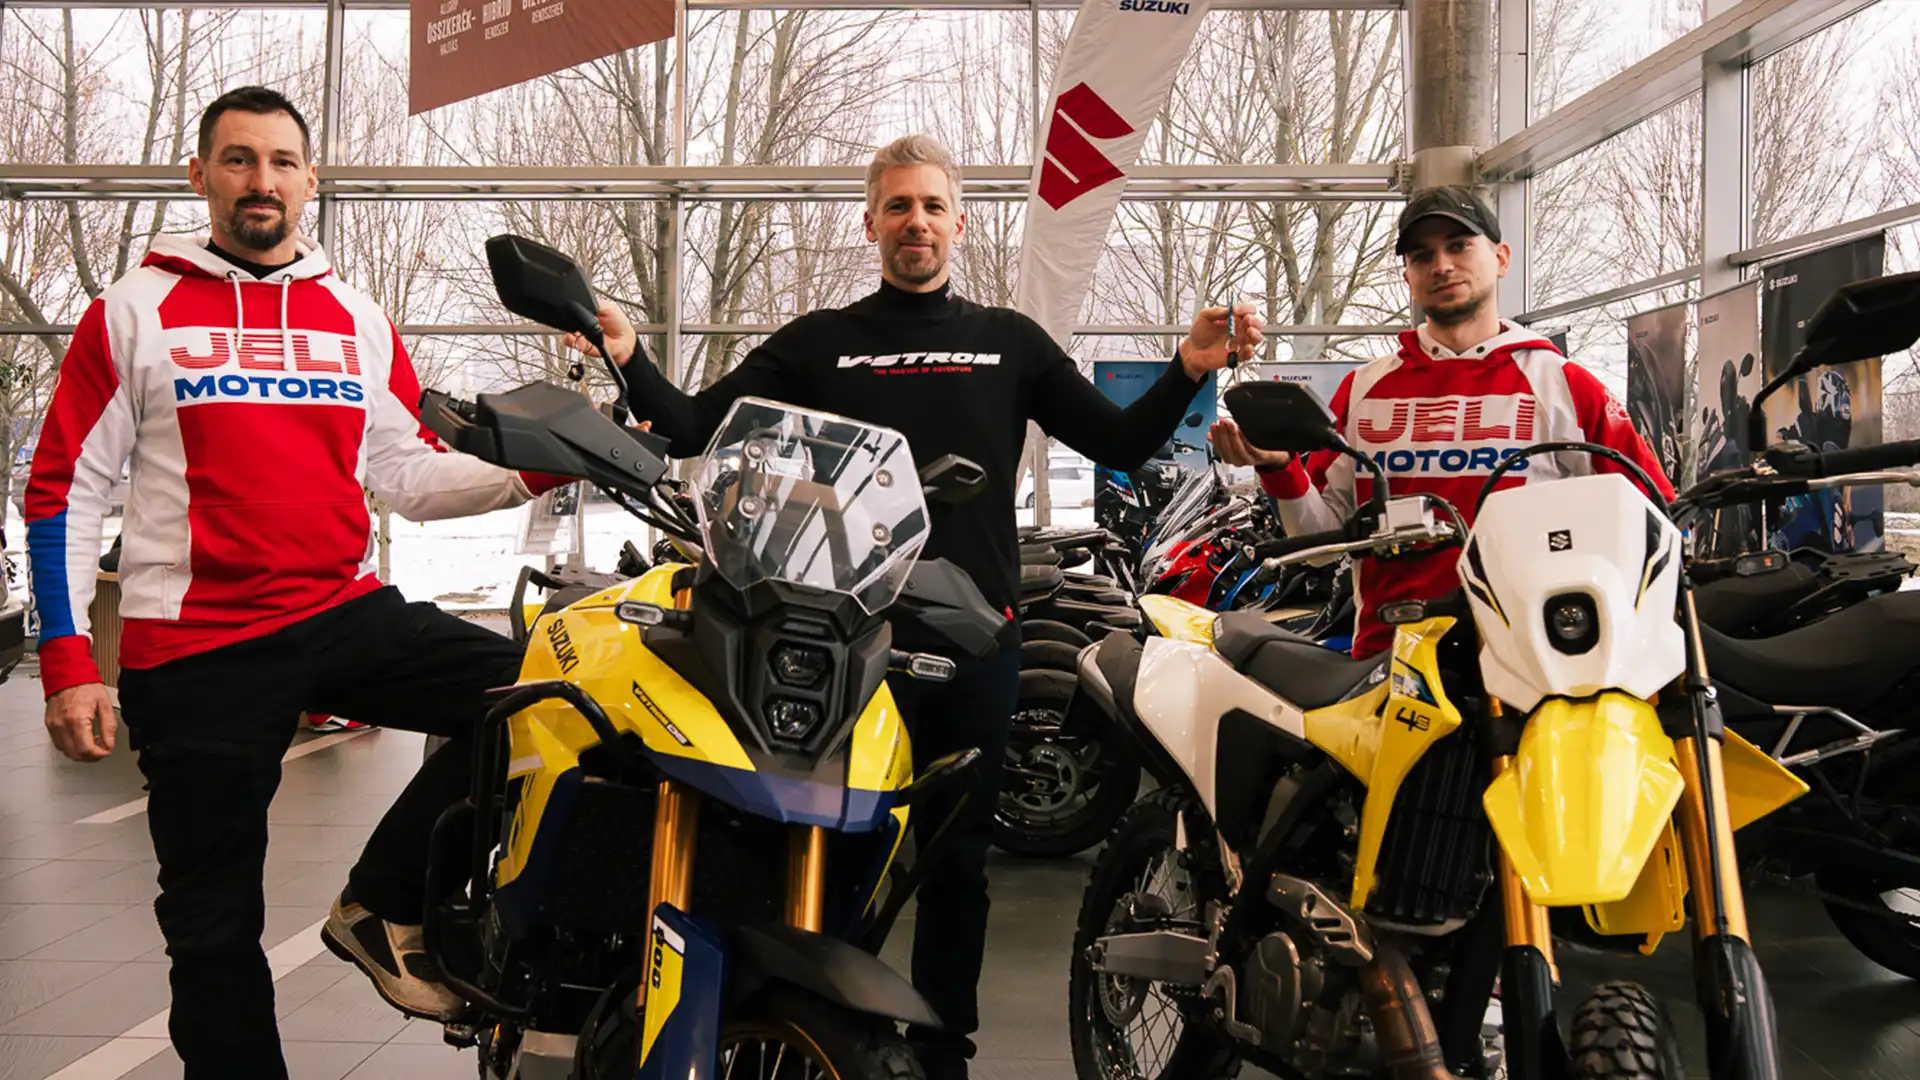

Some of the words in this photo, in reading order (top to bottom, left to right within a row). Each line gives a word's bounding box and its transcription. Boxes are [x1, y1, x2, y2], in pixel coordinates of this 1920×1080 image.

[1119, 0, 1189, 15] SUZUKI
[1776, 275, 1798, 288] SUZUKI
[169, 332, 362, 376] JELI
[836, 352, 1001, 368] V-STROM
[173, 374, 364, 402] MOTORS
[1357, 398, 1536, 444] JELI
[1355, 447, 1530, 473] MOTORS
[547, 618, 580, 676] SUZUKI
